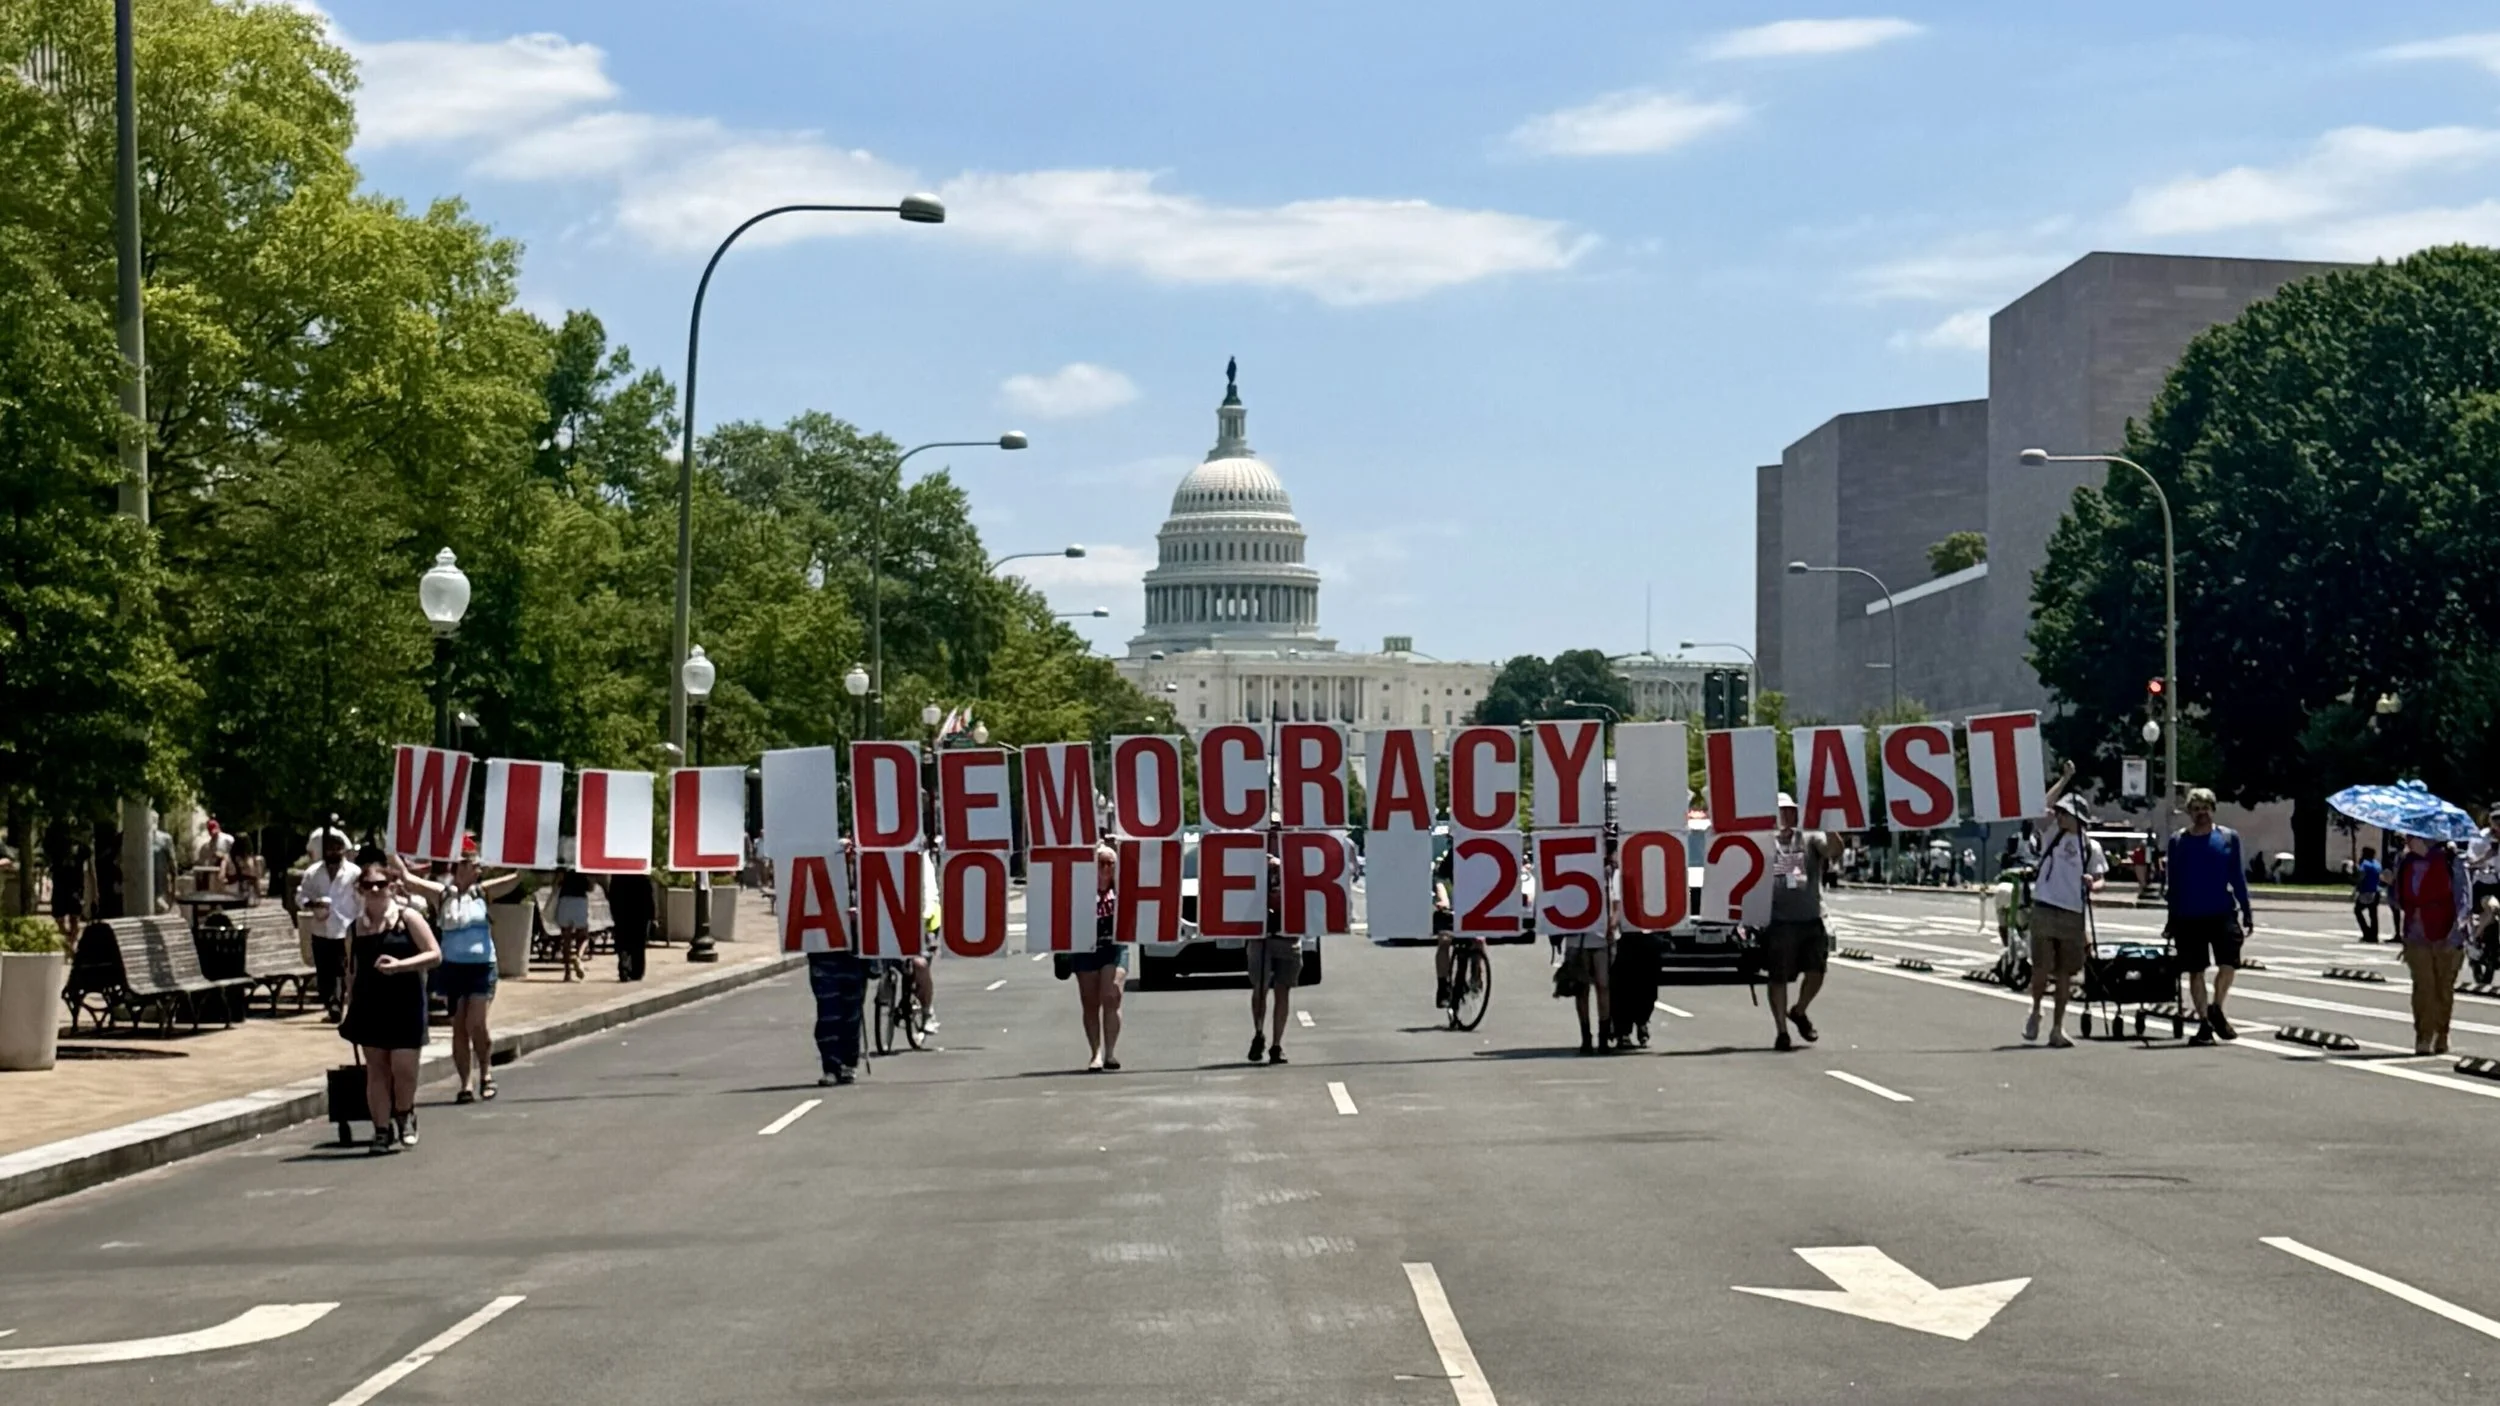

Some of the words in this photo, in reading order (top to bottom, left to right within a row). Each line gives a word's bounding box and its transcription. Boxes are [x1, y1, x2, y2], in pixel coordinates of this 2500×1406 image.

[396, 747, 741, 871] WILL
[854, 722, 1599, 851] DEMOCRACY
[1708, 714, 2034, 833] LAST
[785, 833, 1348, 956] ANOTHER
[1455, 832, 1765, 930] 250?
